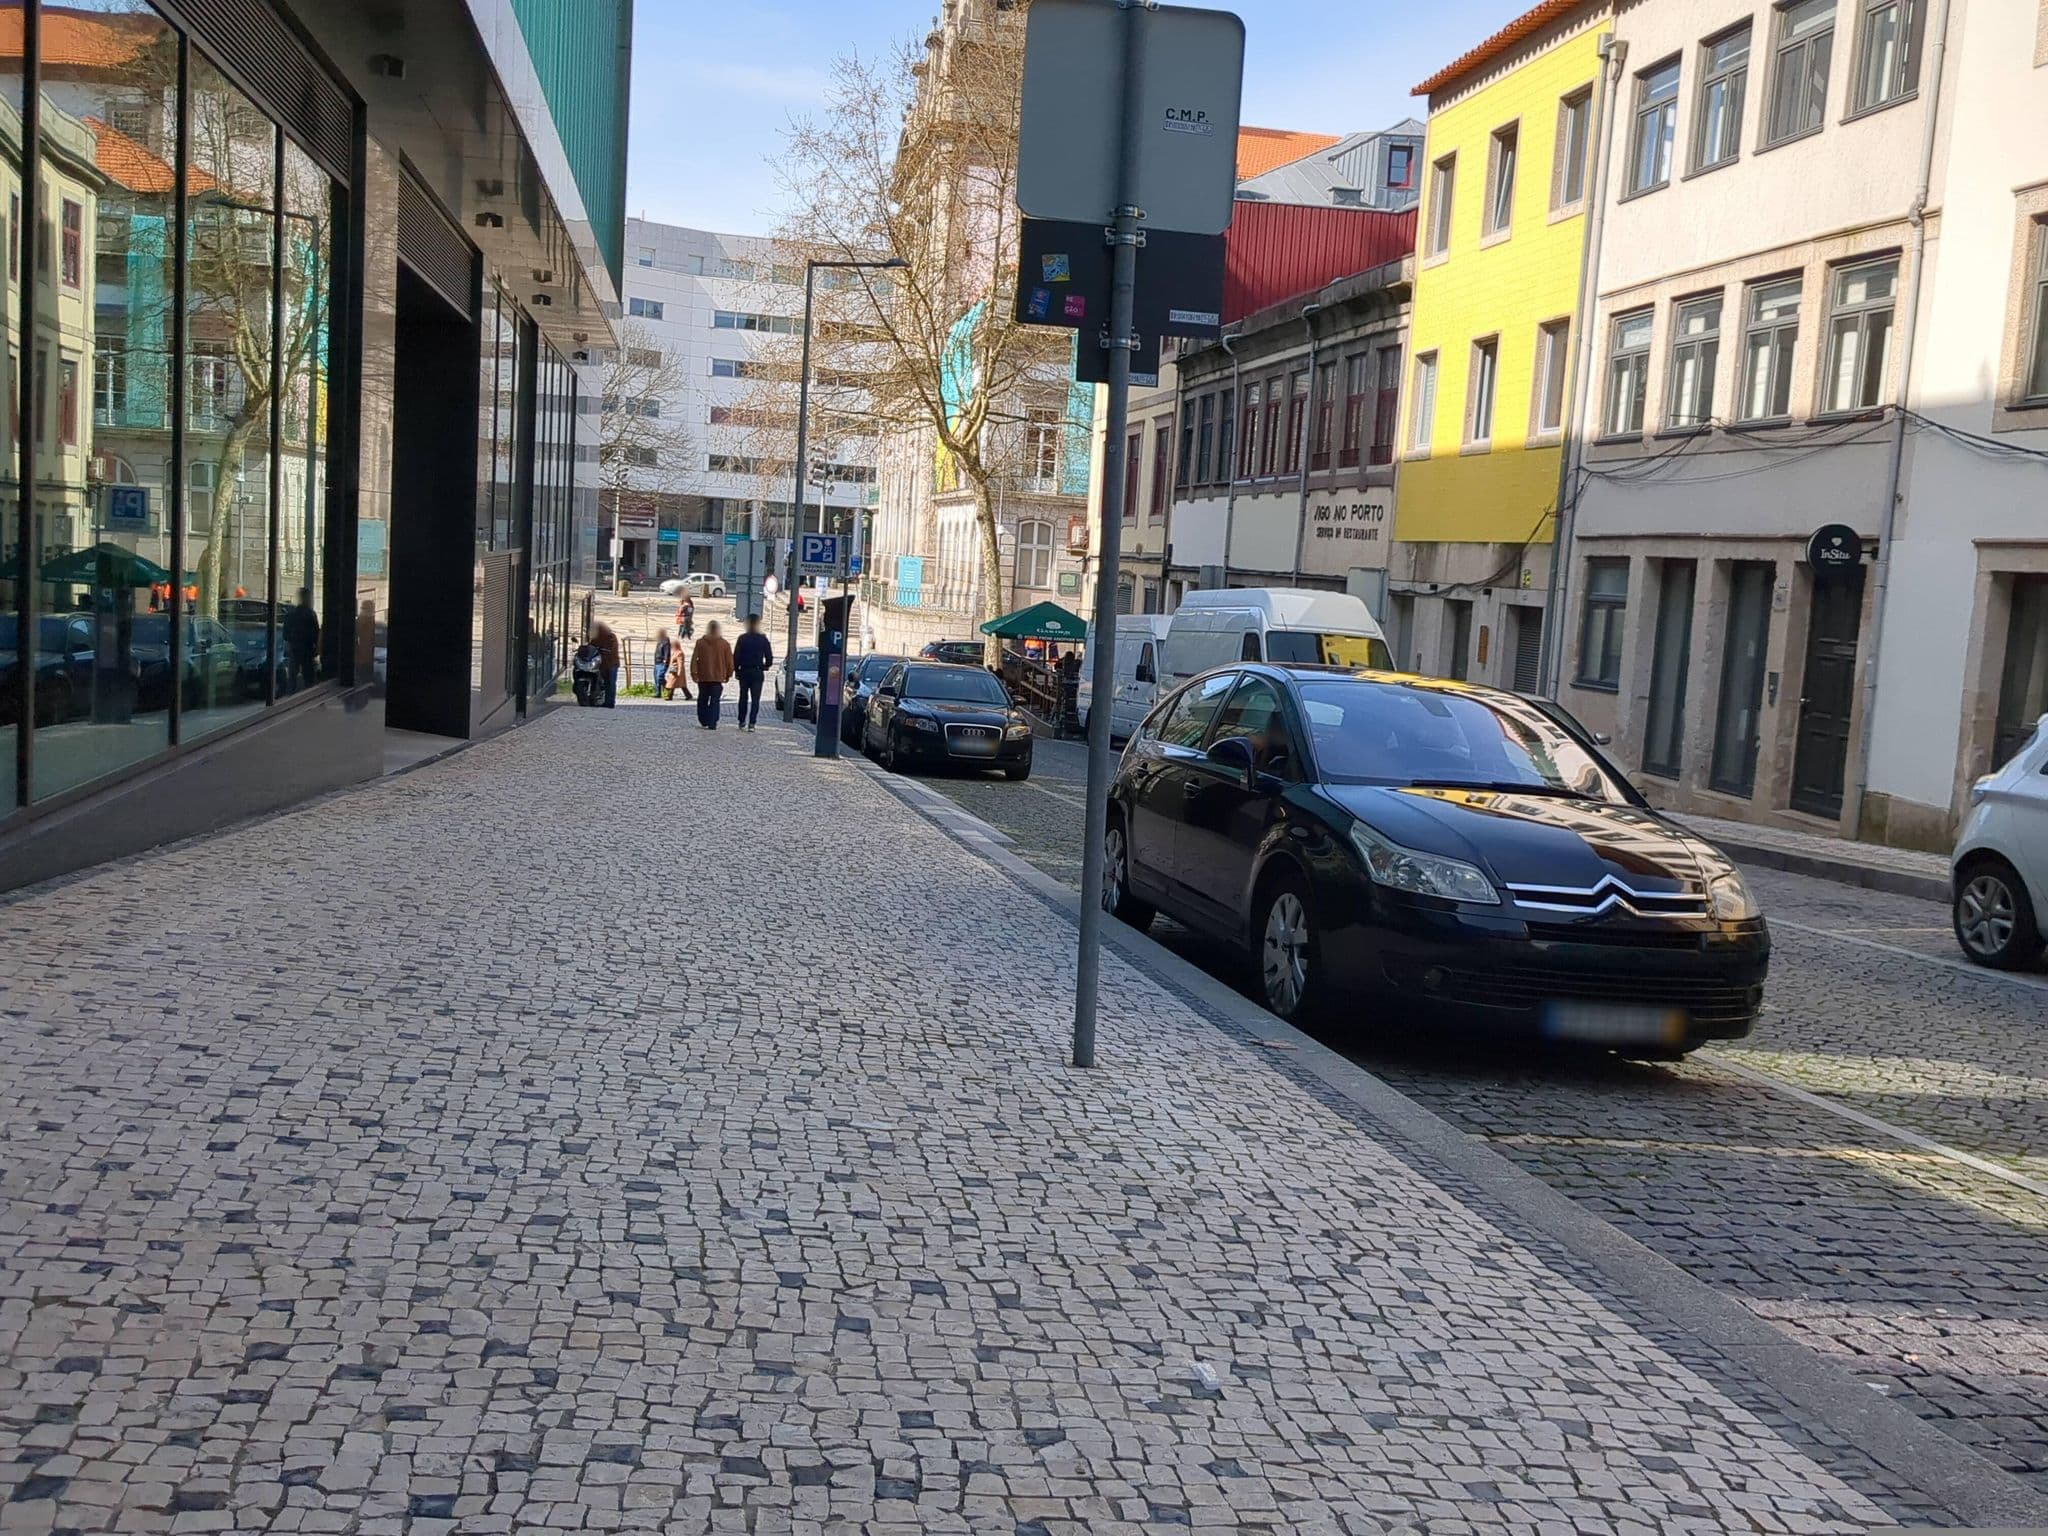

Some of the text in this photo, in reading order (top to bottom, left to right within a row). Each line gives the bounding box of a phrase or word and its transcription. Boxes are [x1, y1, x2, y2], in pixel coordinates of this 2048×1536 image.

[1166, 108, 1209, 123] C.M.P.
[1351, 504, 1384, 522] PORTO
[806, 538, 823, 560] P
[1820, 548, 1851, 560] InSitu
[833, 631, 842, 645] P
